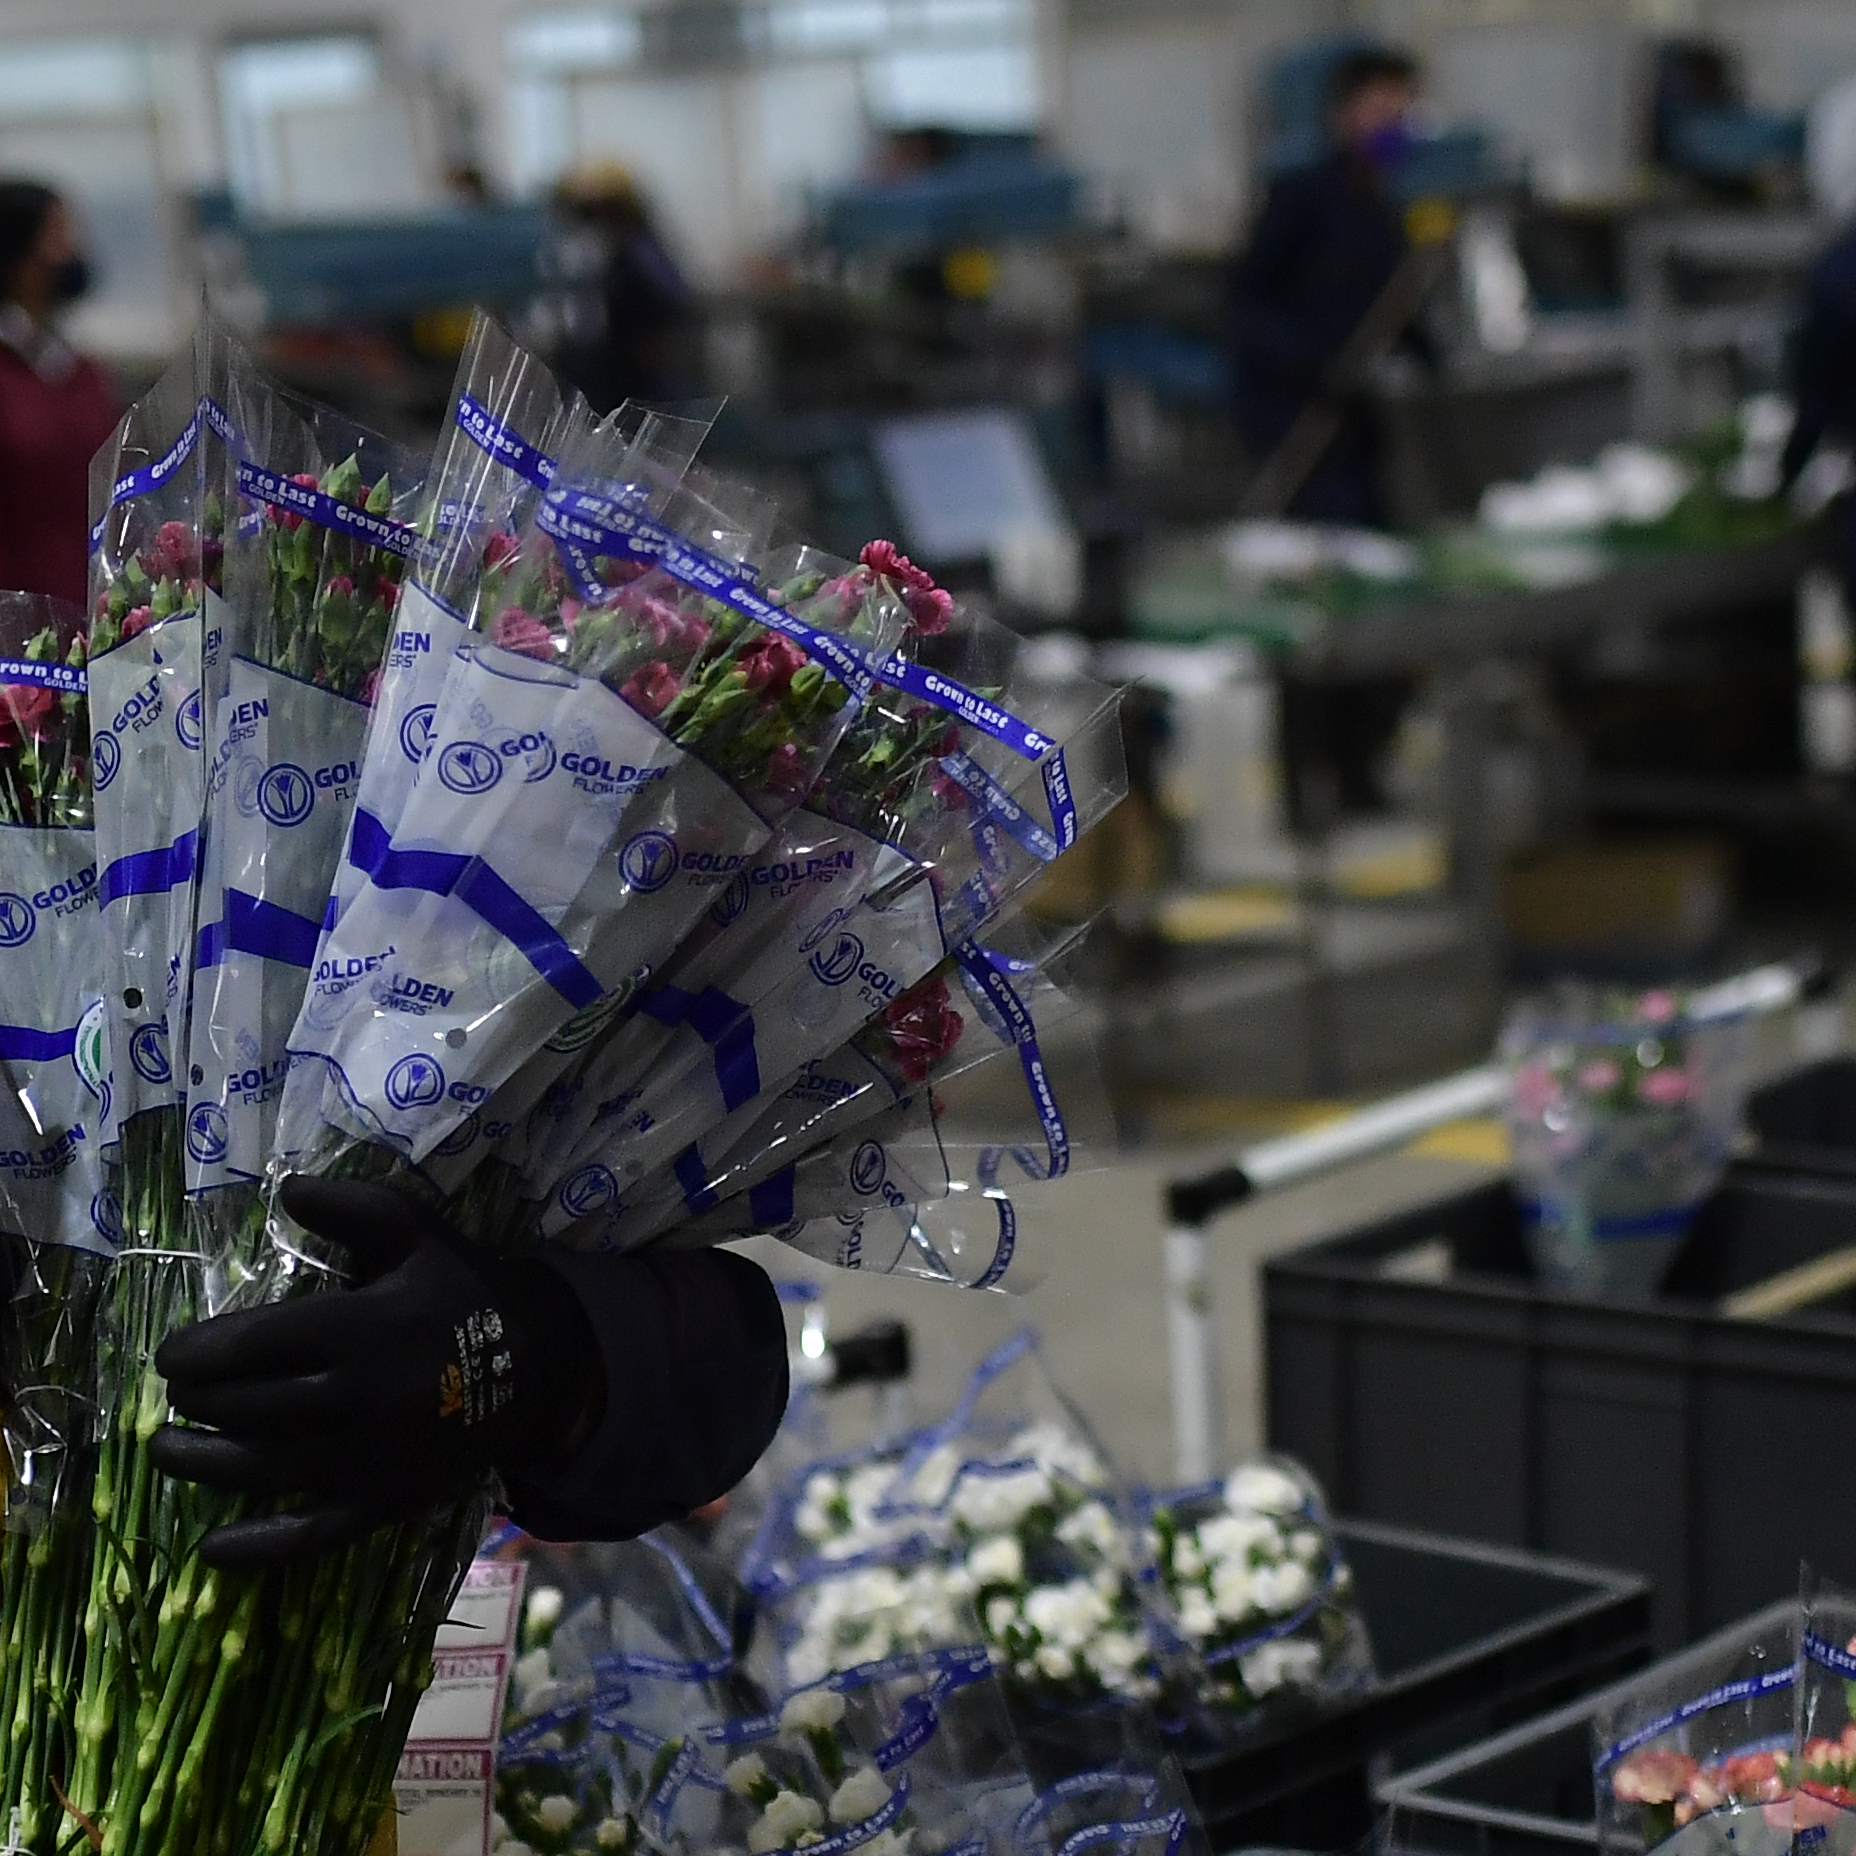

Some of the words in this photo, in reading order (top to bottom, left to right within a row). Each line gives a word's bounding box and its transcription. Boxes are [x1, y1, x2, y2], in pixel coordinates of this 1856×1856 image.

[257, 473, 274, 490] to
[277, 481, 317, 508] Last
[335, 505, 389, 537] Grown
[394, 528, 410, 545] to
[53, 665, 73, 680] to
[814, 636, 855, 673] Grown
[44, 677, 87, 692] GOLDEN
[925, 675, 964, 705] Grown
[964, 695, 976, 711] to
[976, 703, 1009, 729] Last
[113, 674, 161, 734] GOLD
[315, 762, 362, 788] GOL
[561, 752, 669, 782] GOLDEN
[33, 862, 98, 910] GOLD
[393, 973, 455, 1007] LDEN
[859, 962, 908, 999] GOL
[989, 972, 1024, 1023] Grown
[1031, 1061, 1057, 1120] Grown
